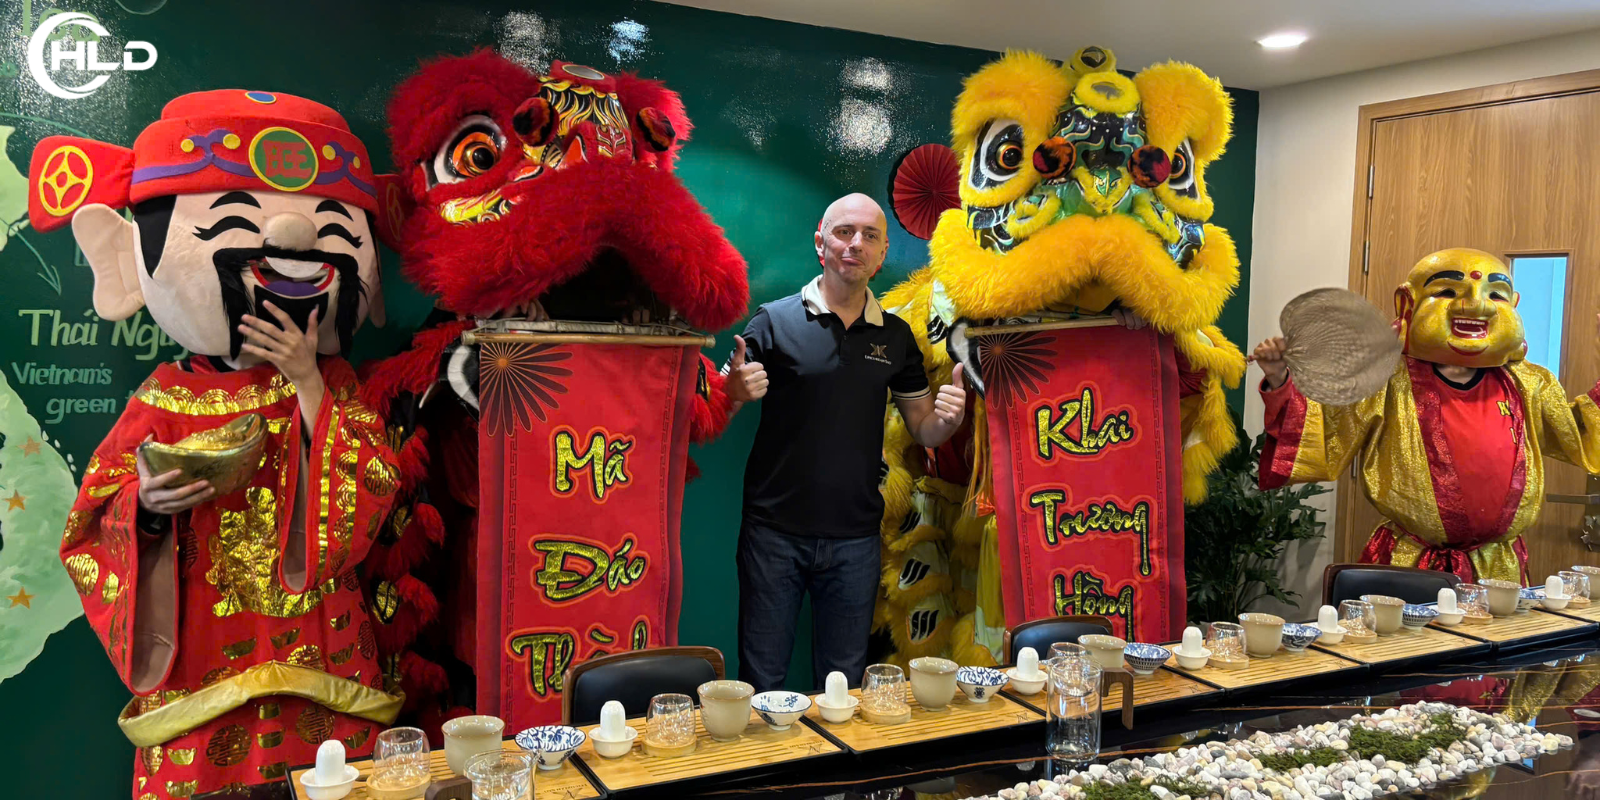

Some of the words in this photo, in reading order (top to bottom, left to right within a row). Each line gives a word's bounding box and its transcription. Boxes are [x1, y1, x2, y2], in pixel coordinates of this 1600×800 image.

[18, 308, 99, 346] Thái
[45, 398, 116, 424] green
[1035, 387, 1134, 459] Khai
[554, 430, 632, 500] Mã
[534, 538, 646, 601] Đáo
[1053, 570, 1135, 643] Hồng
